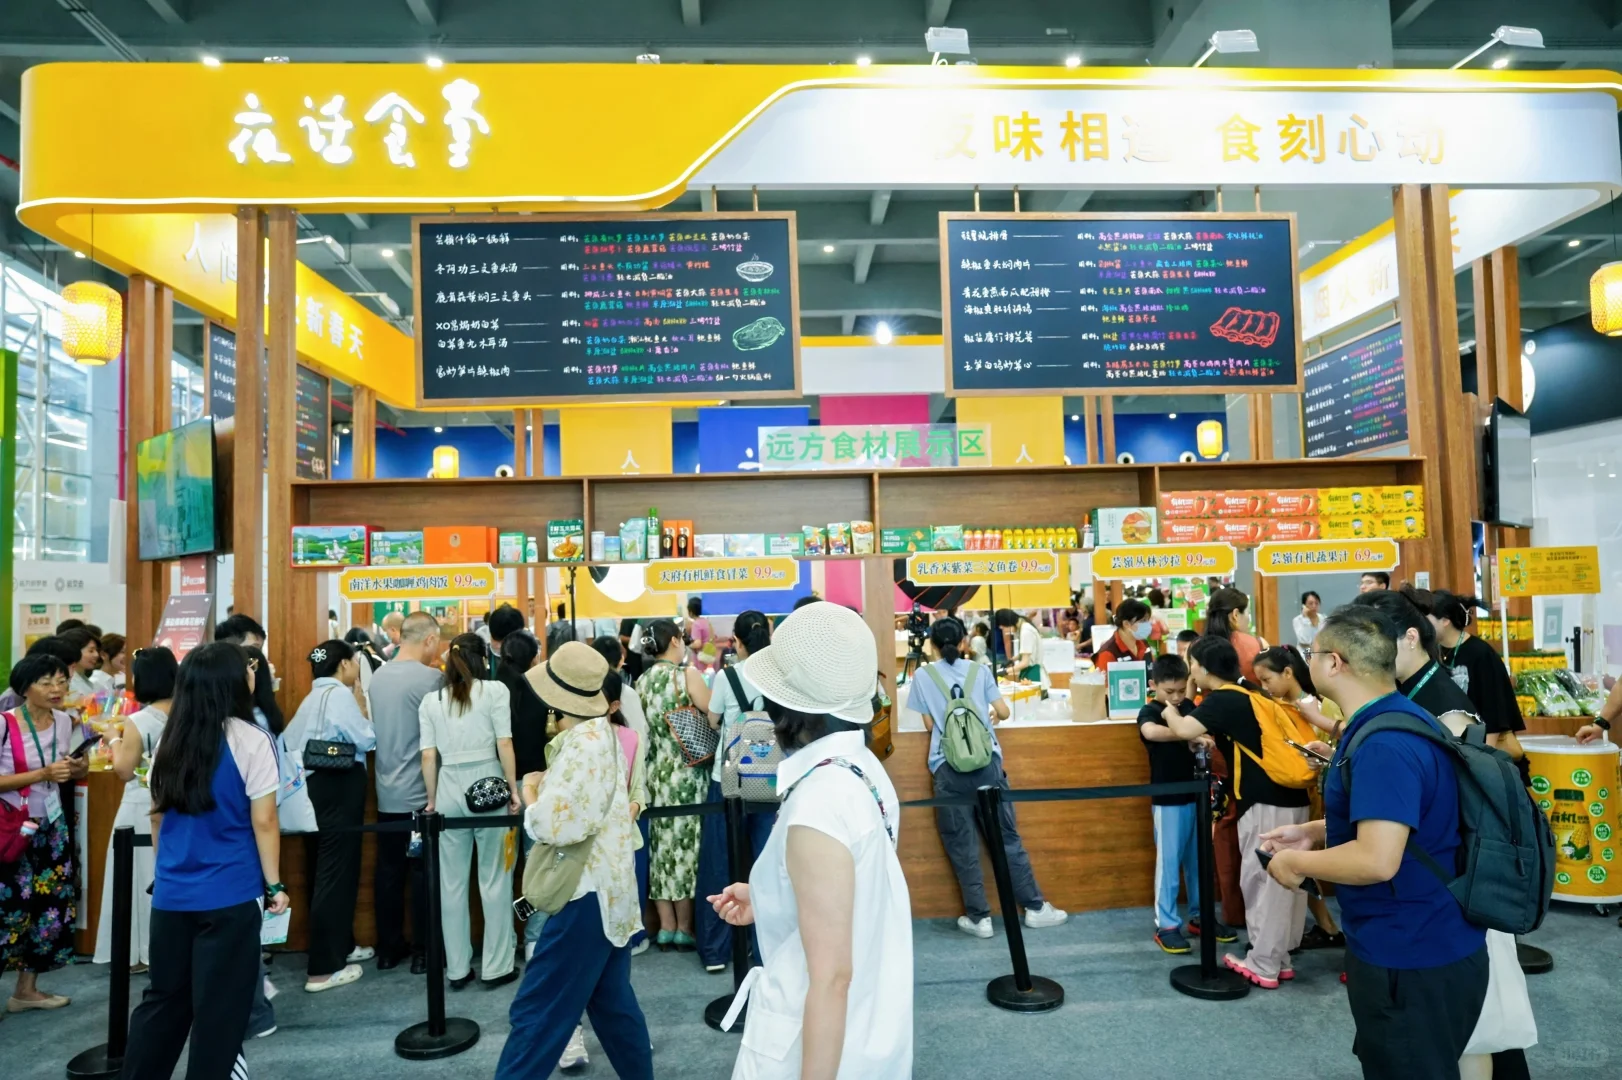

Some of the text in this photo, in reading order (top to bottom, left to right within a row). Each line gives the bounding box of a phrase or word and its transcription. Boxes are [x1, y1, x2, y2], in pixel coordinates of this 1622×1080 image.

[435, 263, 517, 274] 冬阴功三文鱼头汤
[438, 337, 508, 349] 白菜鱼丸木耳汤
[766, 429, 985, 461] 远方食材展示区
[1111, 555, 1181, 569] 芸嶺丛林沙拉
[1271, 550, 1349, 565] 芸嶺有机蔬果汁
[917, 560, 1017, 575] 乳香米紫菜三文鱼卷
[659, 568, 748, 583] 天府有机鲜食冒菜
